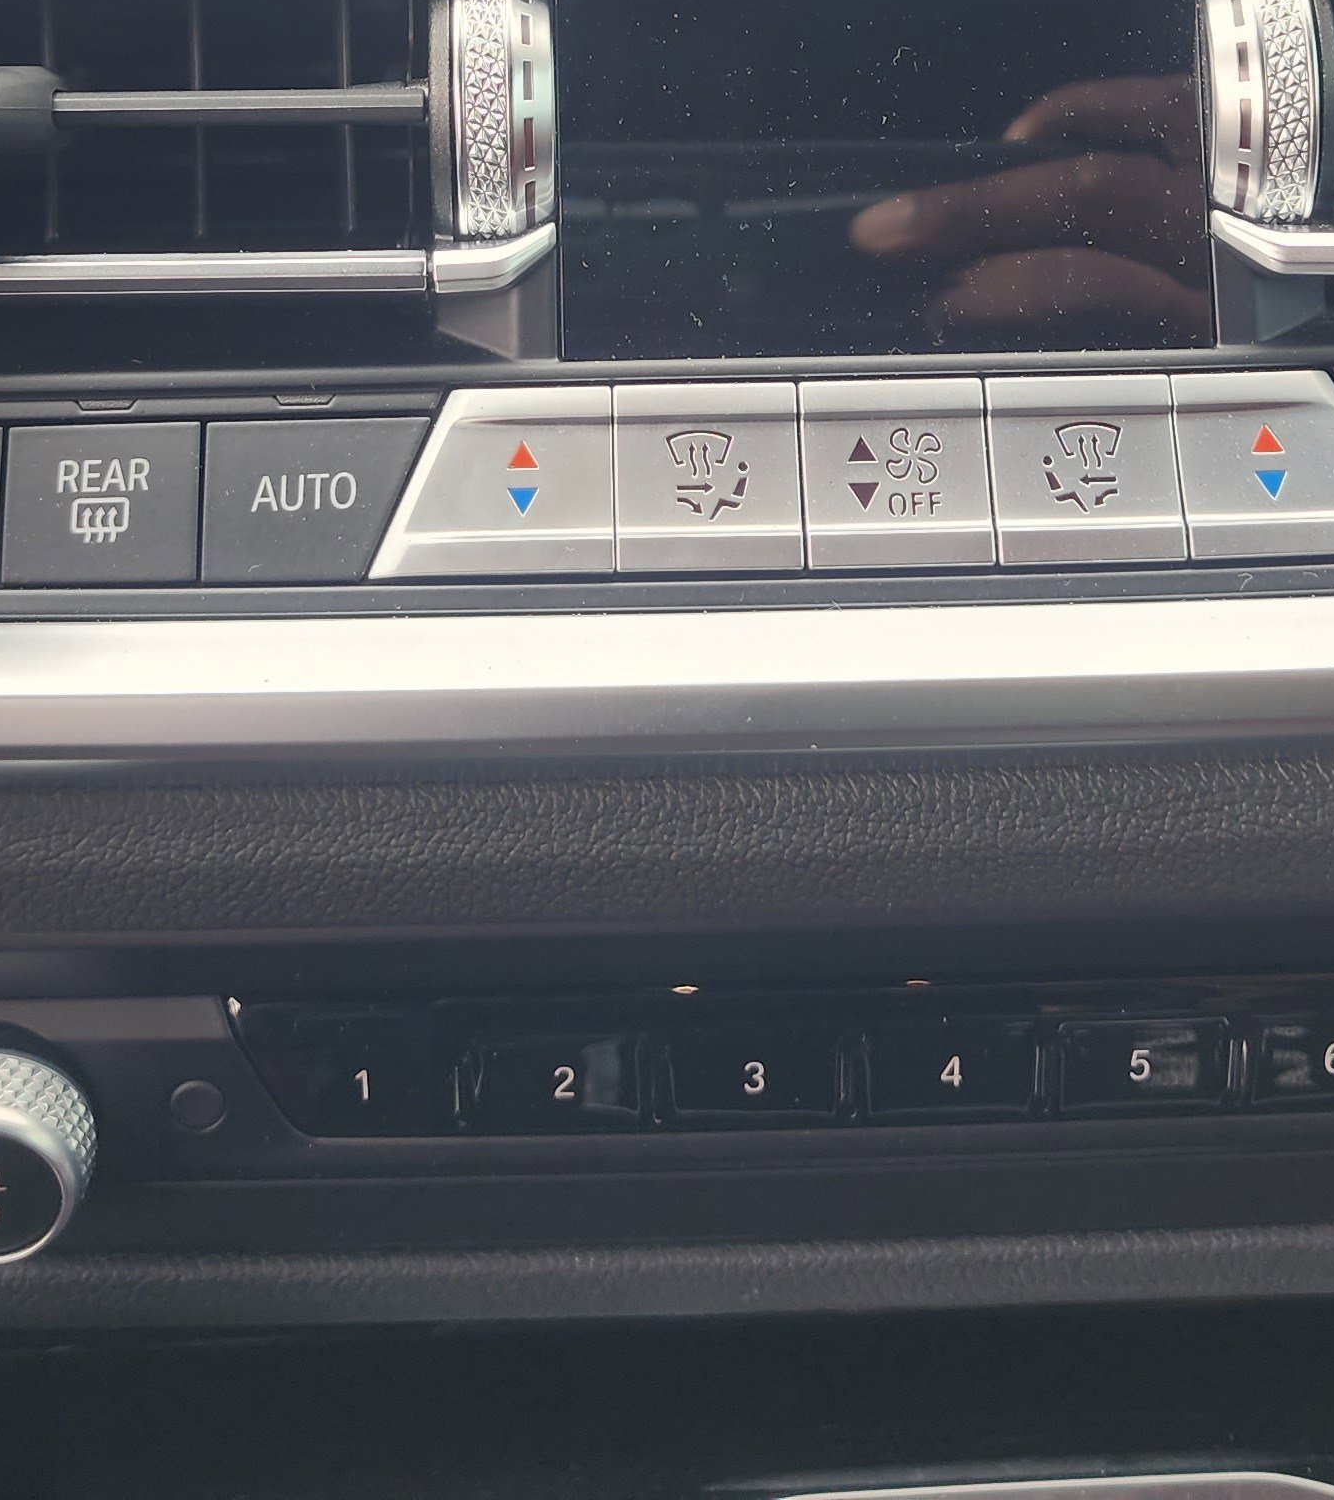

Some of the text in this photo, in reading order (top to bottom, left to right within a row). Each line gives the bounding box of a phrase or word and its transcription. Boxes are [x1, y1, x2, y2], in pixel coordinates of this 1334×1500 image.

[57, 458, 150, 493] REAR
[250, 471, 357, 512] AUTO
[887, 490, 942, 517] OFF
[744, 1061, 765, 1094] 3
[940, 1055, 963, 1087] 4
[1129, 1049, 1150, 1082] 5
[355, 1069, 369, 1100] 1
[554, 1066, 575, 1099] 2
